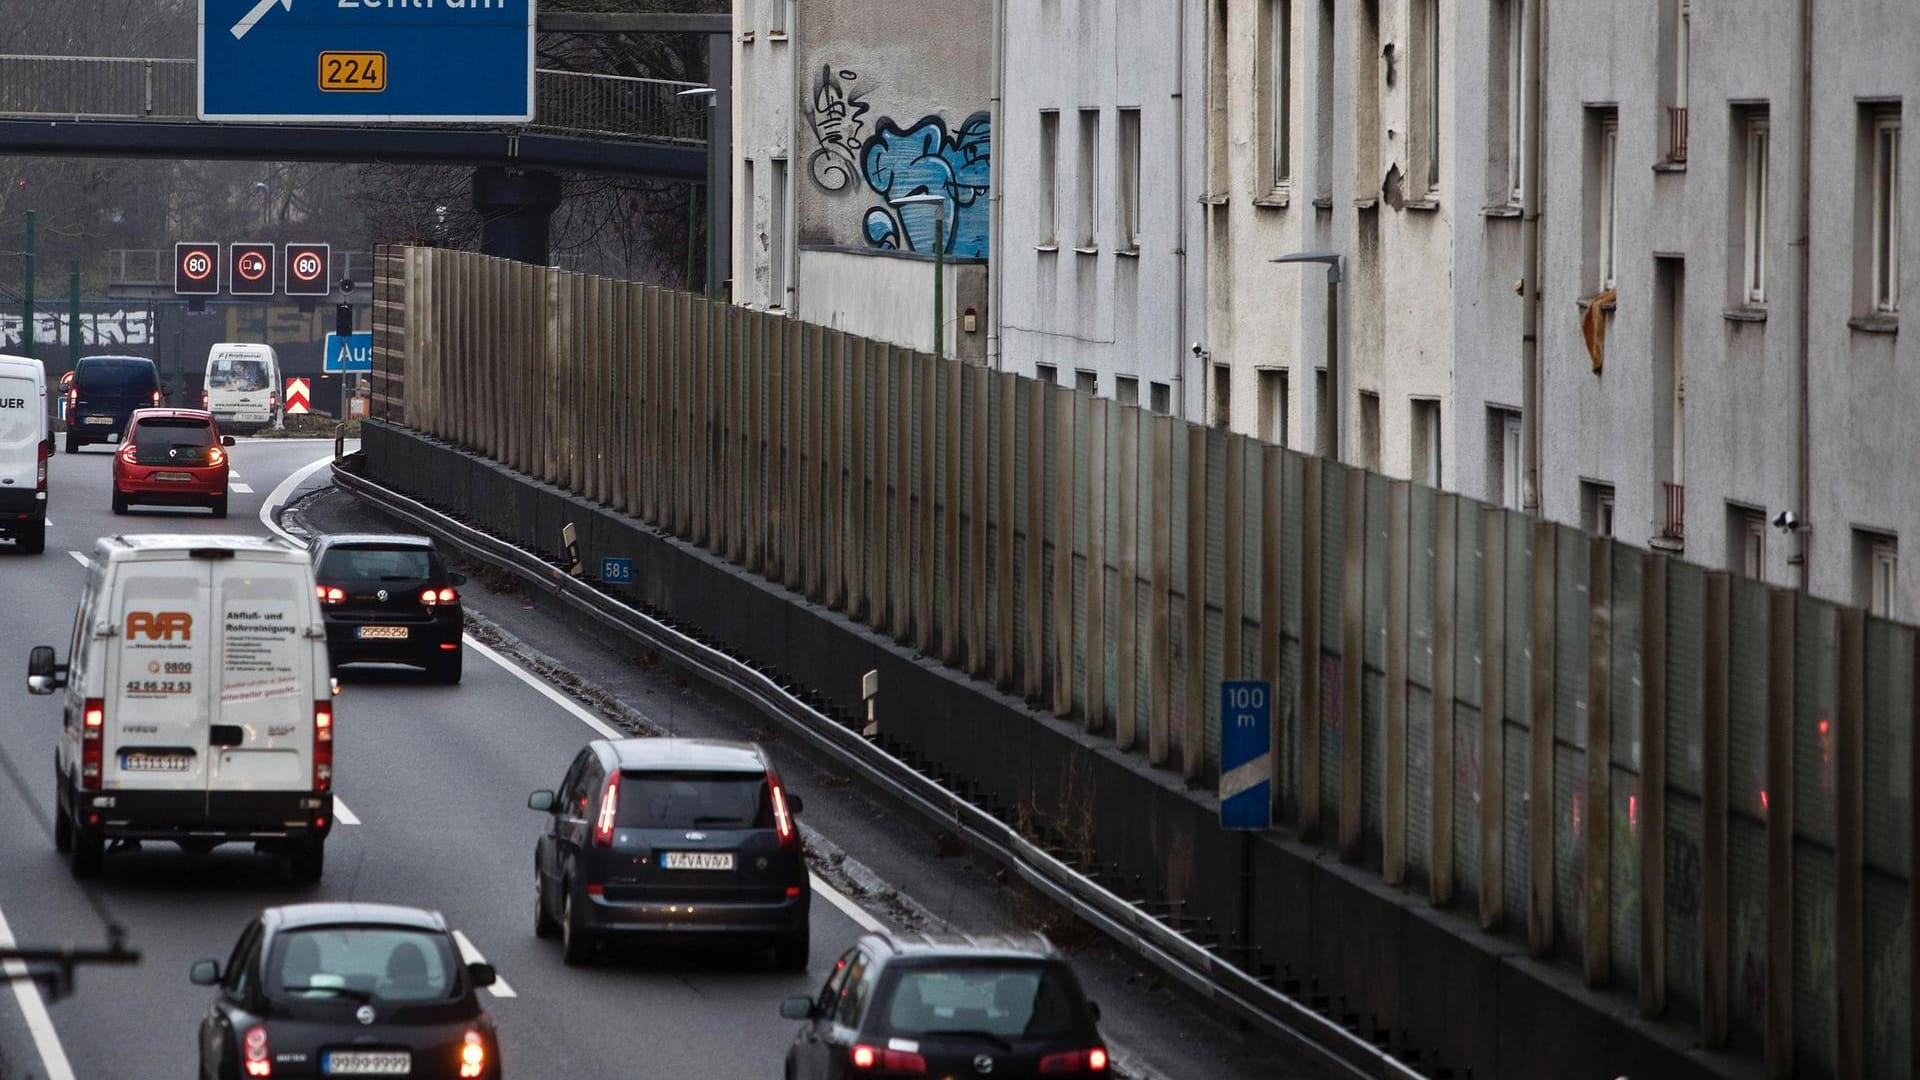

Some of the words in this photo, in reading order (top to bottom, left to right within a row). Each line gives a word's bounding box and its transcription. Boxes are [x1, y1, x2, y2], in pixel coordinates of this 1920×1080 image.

[327, 59, 376, 83] 224
[189, 259, 206, 272] 80
[299, 260, 316, 273] 80
[264, 612, 282, 620] und
[165, 662, 192, 673] 0800
[1229, 688, 1264, 709] 100
[1237, 714, 1256, 728] m
